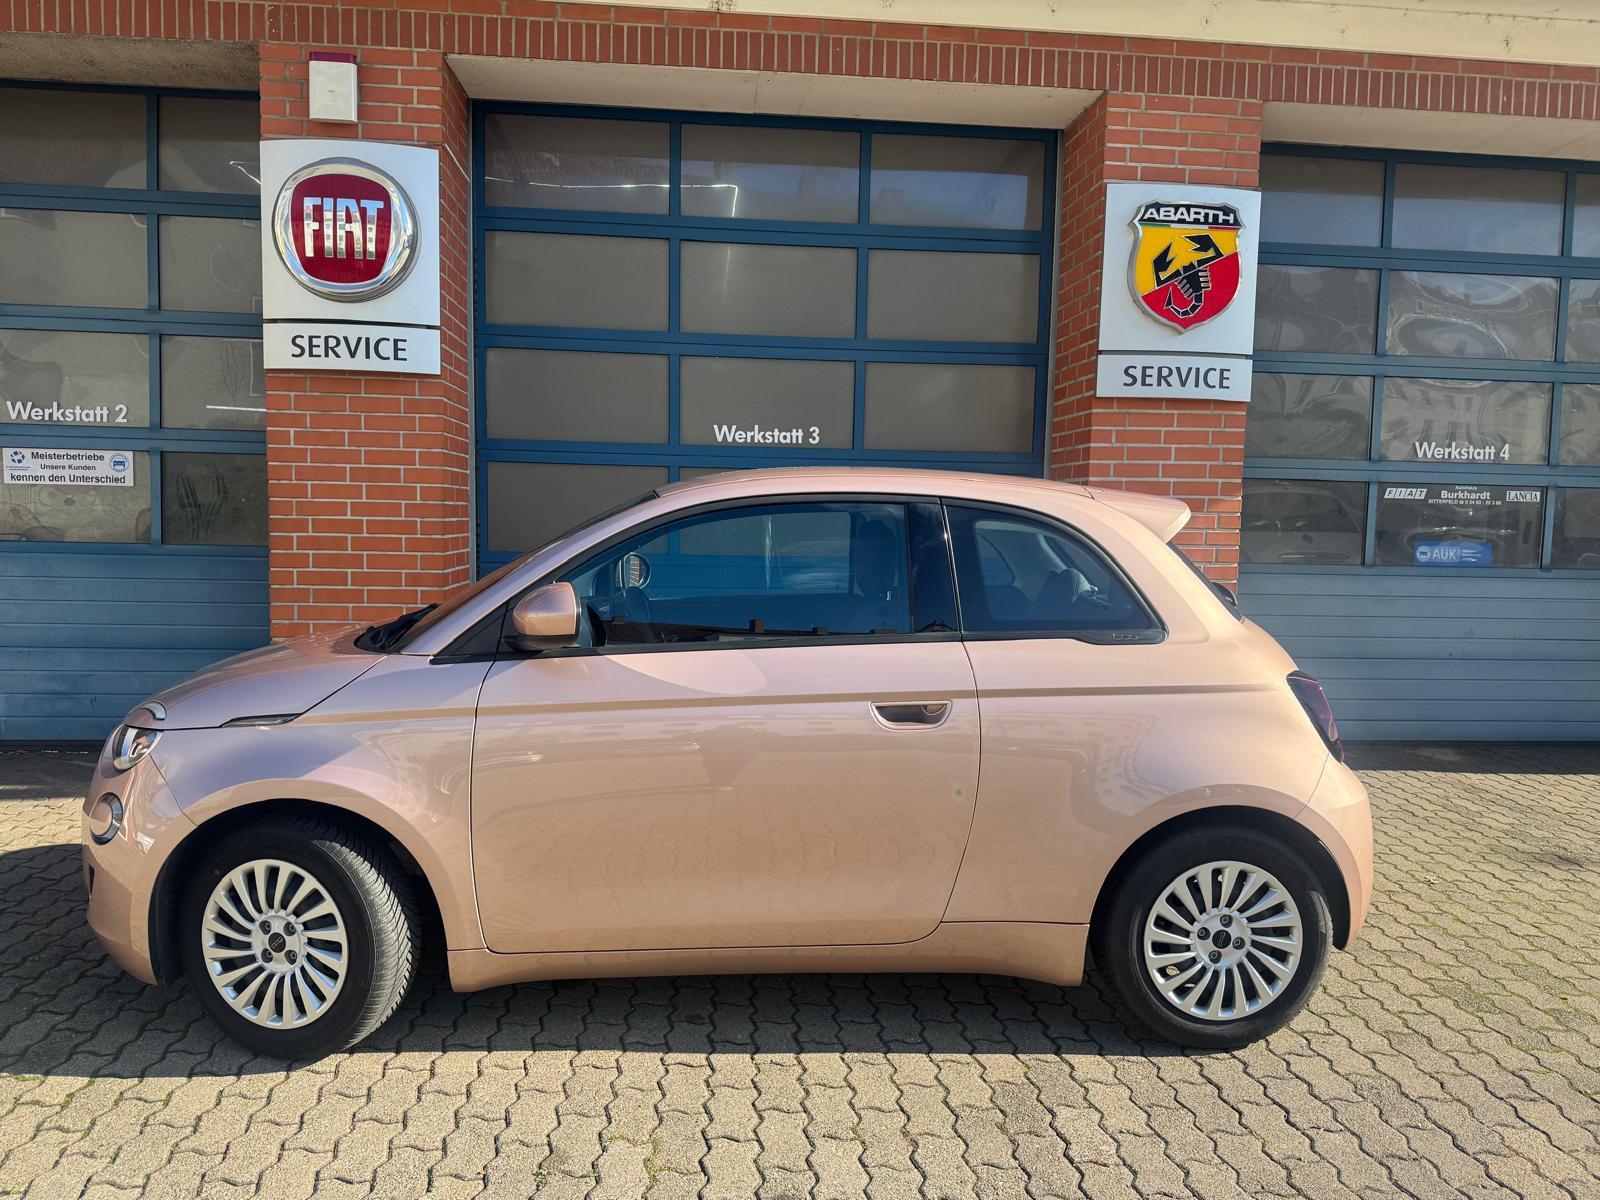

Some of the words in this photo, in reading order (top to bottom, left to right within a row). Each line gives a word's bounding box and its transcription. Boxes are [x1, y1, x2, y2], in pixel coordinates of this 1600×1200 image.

[1143, 206, 1235, 224] ABARTH
[303, 197, 384, 260] FIAT
[291, 334, 408, 362] SERVICE
[1123, 365, 1231, 390] SERVICE
[6, 400, 109, 423] Werkstatt
[114, 404, 128, 423] 2
[713, 424, 804, 444] Werkstatt
[808, 426, 820, 444] 3
[31, 451, 105, 462] Meisterbetriebe
[1415, 441, 1496, 461] Werkstatt
[1500, 443, 1510, 461] 4
[40, 463, 66, 471] Unsere
[10, 473, 46, 482] kennen
[48, 474, 66, 483] den
[68, 474, 126, 484] Unterschied
[1384, 487, 1427, 500] FIAT
[1440, 490, 1491, 500] Burkhardt
[1506, 490, 1541, 503] LANCIA
